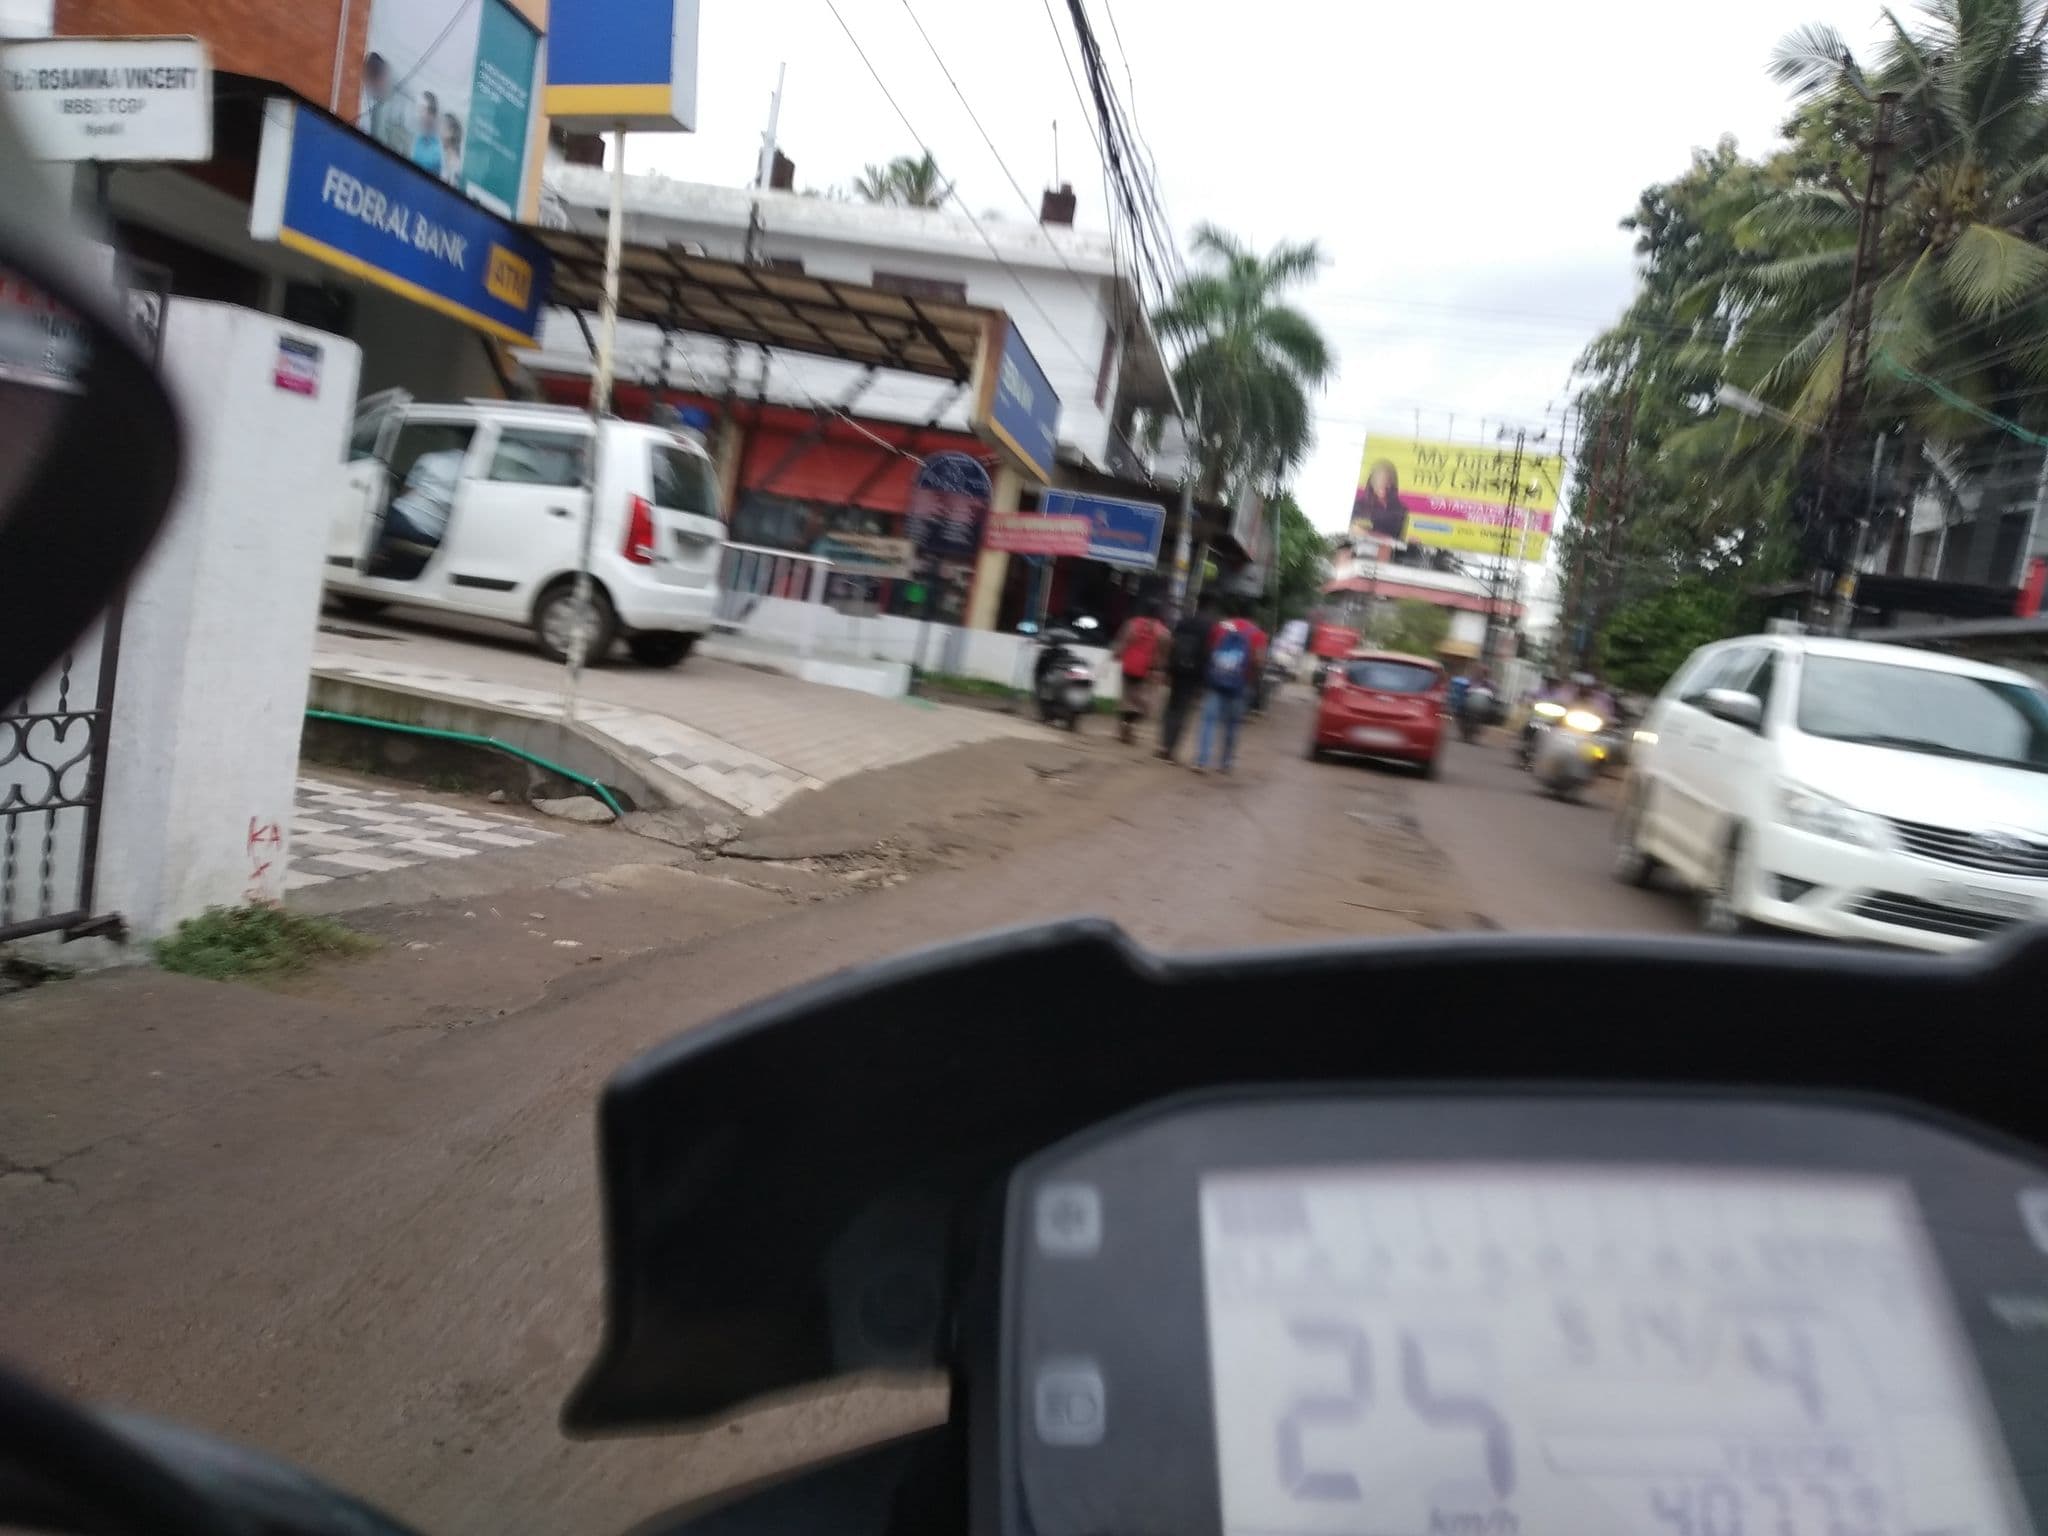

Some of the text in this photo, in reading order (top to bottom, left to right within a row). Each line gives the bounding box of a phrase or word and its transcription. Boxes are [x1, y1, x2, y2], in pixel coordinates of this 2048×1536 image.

[321, 164, 468, 272] FEDERAL BANK
[1275, 1316, 1517, 1502] 25
